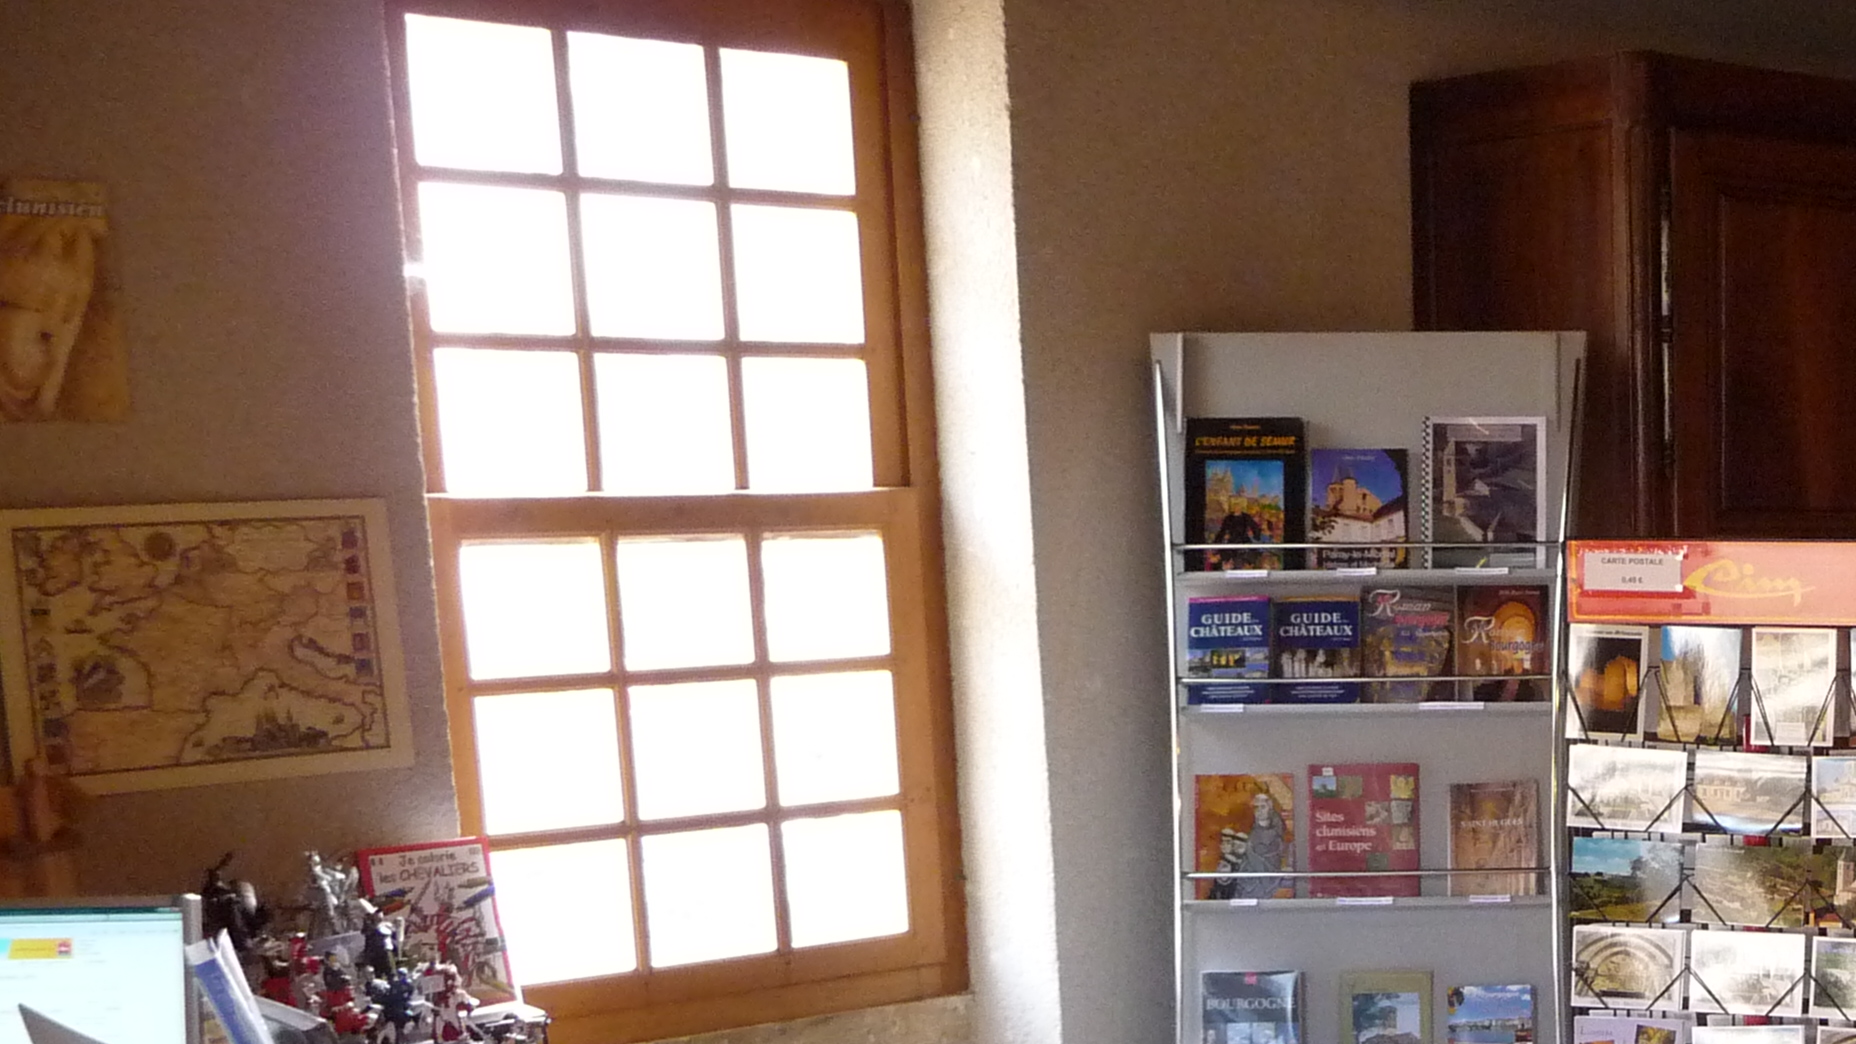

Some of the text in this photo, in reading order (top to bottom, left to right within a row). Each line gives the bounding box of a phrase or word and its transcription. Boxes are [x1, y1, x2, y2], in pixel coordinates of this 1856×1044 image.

[1244, 436, 1258, 446] DE
[1601, 557, 1664, 566] CARTE POSTALE
[1201, 612, 1252, 625] GUIDE
[1290, 612, 1342, 624] GUIDE
[1190, 624, 1263, 638] CHÂTEAUX
[1279, 624, 1353, 637] CHÂTEAUX
[1315, 810, 1345, 823] Sites
[1316, 825, 1377, 837] clunisiens
[1328, 840, 1373, 853] Europe
[399, 854, 415, 867] Je
[400, 861, 479, 881] CHEVALIERS
[1206, 997, 1296, 1010] BOURGOGNE
